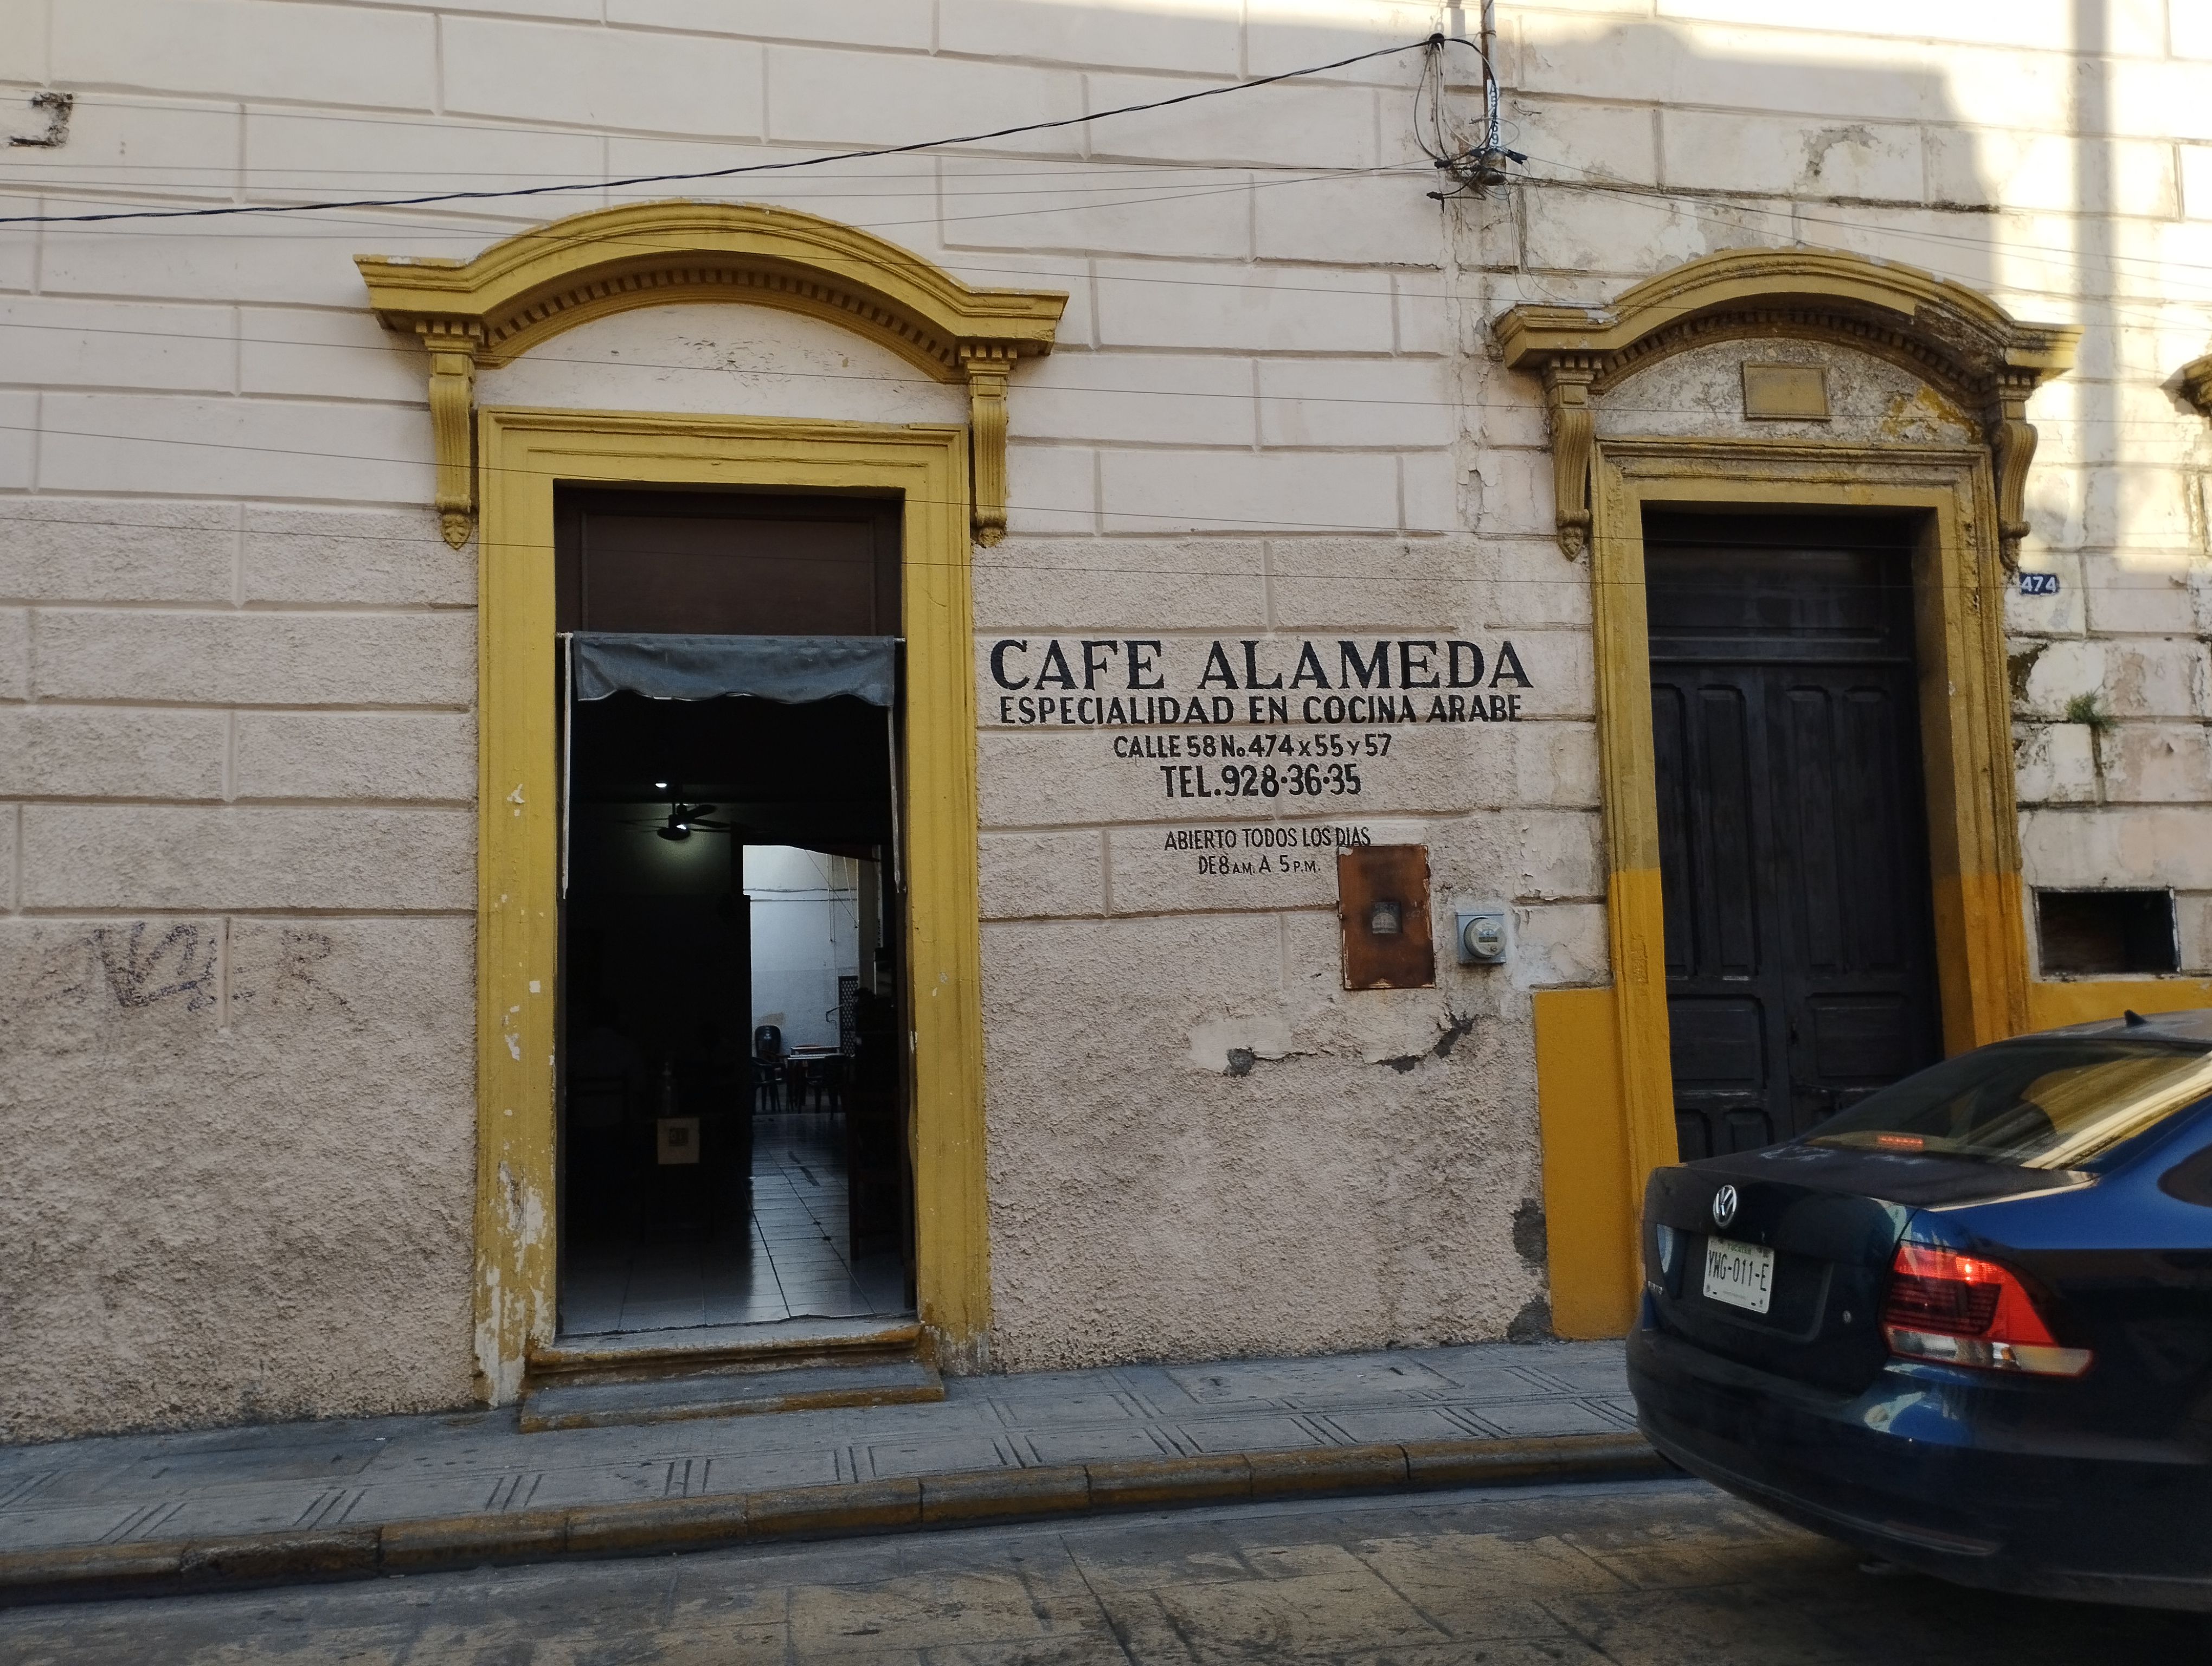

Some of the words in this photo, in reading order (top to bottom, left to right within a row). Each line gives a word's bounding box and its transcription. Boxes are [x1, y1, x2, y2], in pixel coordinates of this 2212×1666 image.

[2022, 576, 2056, 592] 474
[991, 640, 1164, 690] CAFE
[1197, 640, 1534, 690] ALAMEDA
[1000, 696, 1234, 726] ESPECIALIDAD
[1248, 696, 1288, 725] EN
[1303, 695, 1417, 724] COCINA
[1425, 694, 1523, 723] ARABE
[1114, 735, 1181, 758] CALLE
[1187, 735, 1216, 758] 58
[1248, 734, 1295, 757] 474
[1315, 734, 1344, 757] 55
[1365, 733, 1392, 757] 57
[1164, 829, 1237, 850] ABIERTO
[1242, 827, 1298, 848] TODOS
[1302, 827, 1333, 847] LOS
[1336, 827, 1371, 846] DIAS
[1199, 855, 1217, 875] DE
[1258, 855, 1272, 875] A
[1279, 854, 1290, 873] 5
